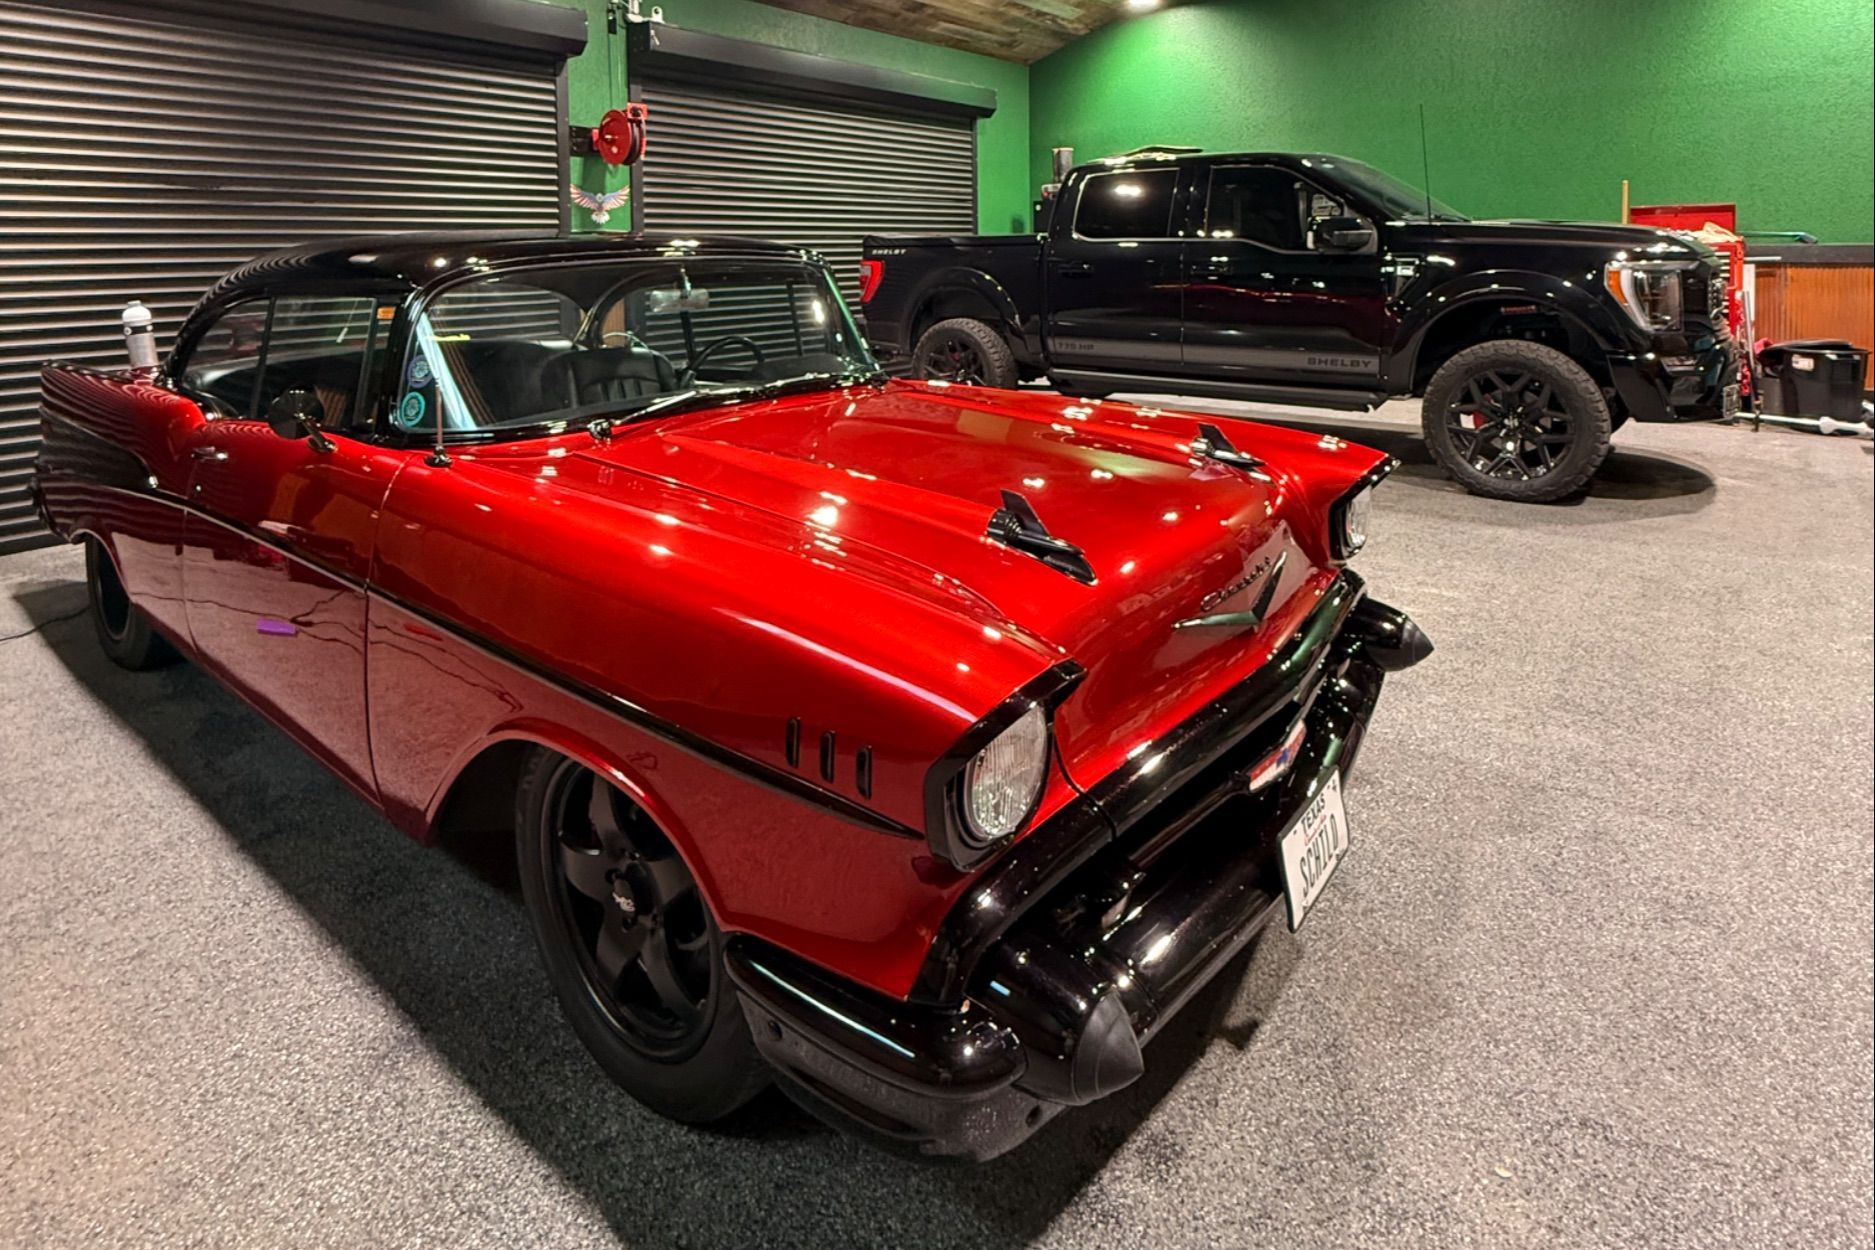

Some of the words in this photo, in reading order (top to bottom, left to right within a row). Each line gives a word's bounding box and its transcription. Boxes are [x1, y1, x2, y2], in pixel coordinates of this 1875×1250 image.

[1307, 357, 1372, 369] SHELBY
[1300, 792, 1326, 837] TEXAS
[1300, 813, 1339, 898] SCHILD
